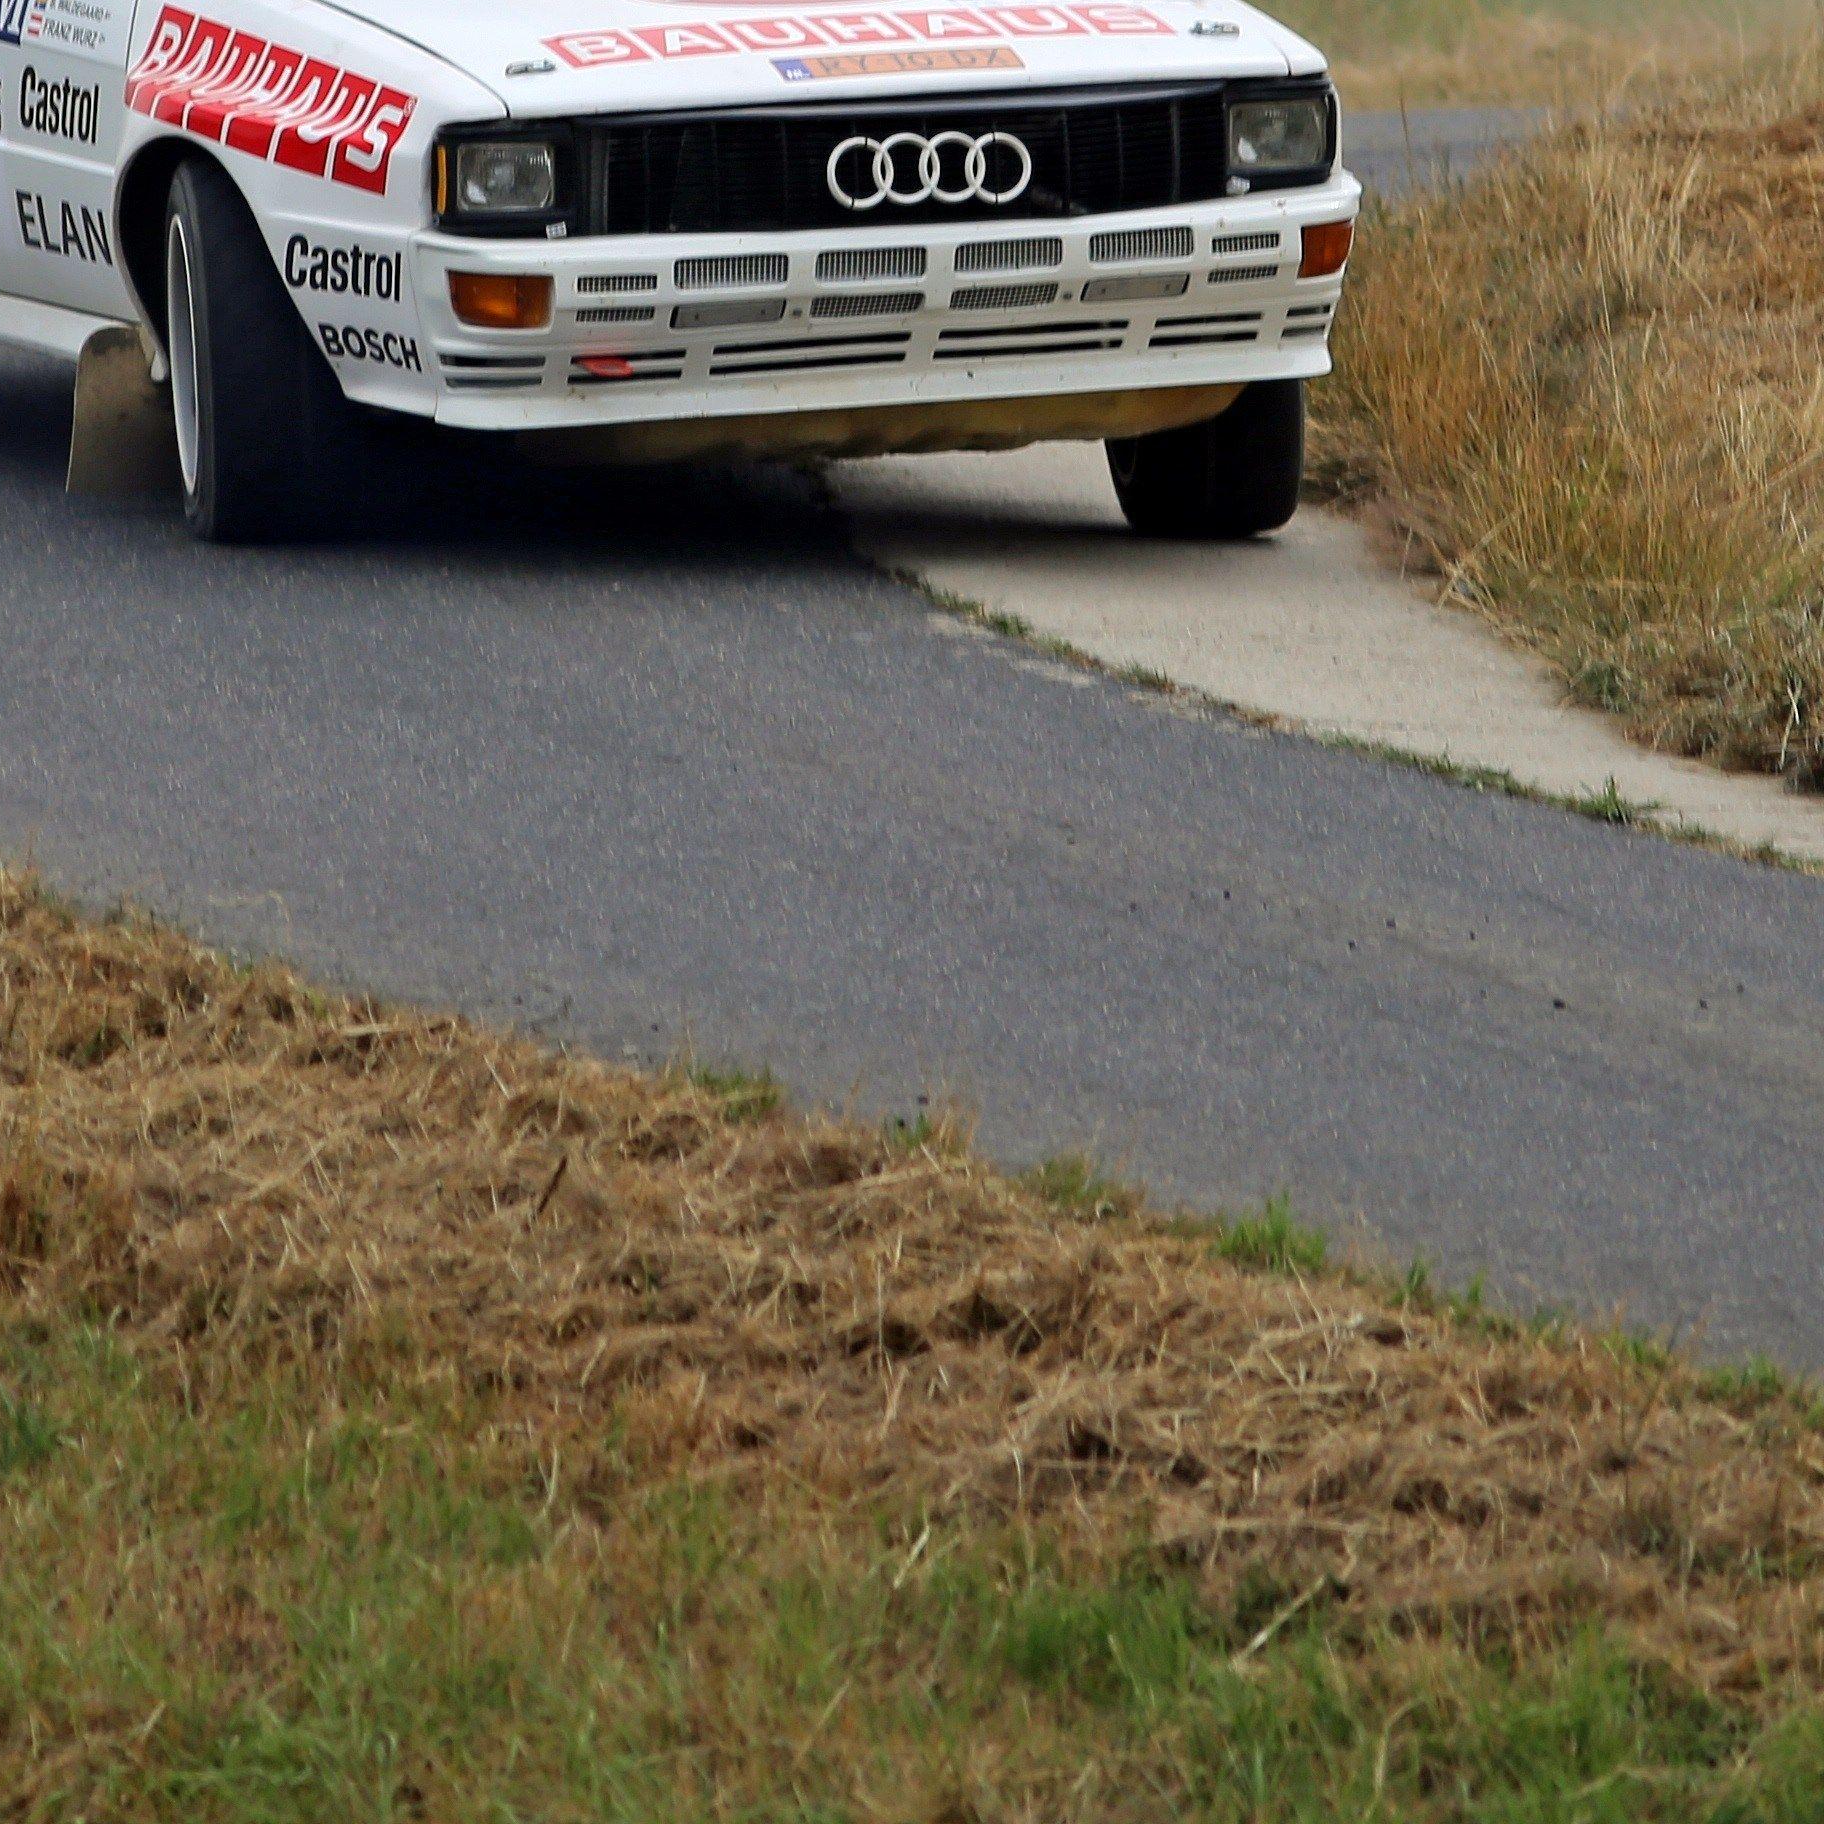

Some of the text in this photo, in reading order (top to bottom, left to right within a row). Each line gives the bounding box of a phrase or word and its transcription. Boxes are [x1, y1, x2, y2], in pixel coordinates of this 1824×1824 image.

[570, 7, 1159, 64] BAUHAUS
[20, 64, 99, 145] Castrol
[131, 20, 405, 173] BAUHAUS
[16, 188, 114, 266] ELAN
[284, 233, 402, 303] Castrol
[318, 322, 422, 373] BOSCH
